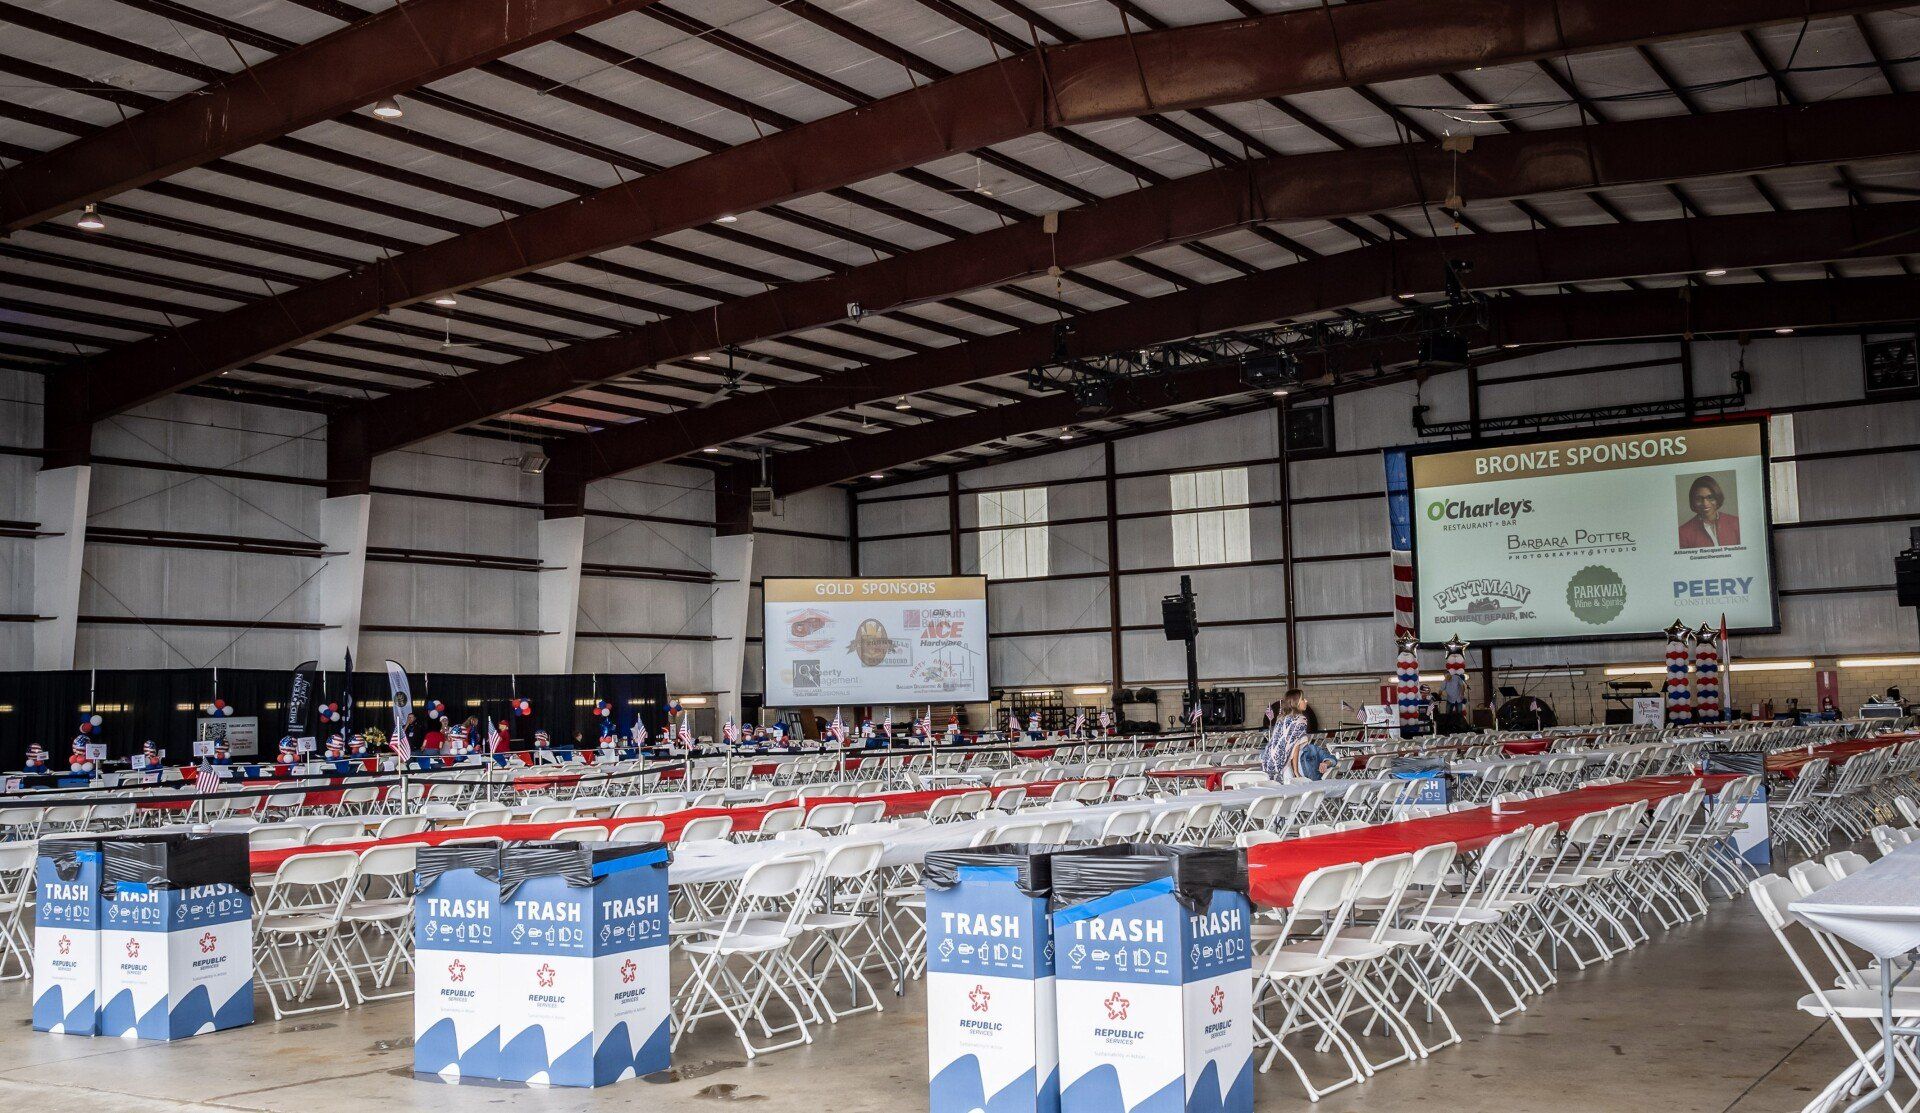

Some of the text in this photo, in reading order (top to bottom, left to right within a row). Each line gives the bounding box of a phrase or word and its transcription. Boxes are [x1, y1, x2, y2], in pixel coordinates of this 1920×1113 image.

[1475, 436, 1688, 475] BRONZE SPONSORS
[1427, 498, 1532, 521] O'Charley's
[1443, 521, 1493, 531] RESTAURANT
[1501, 519, 1517, 527] BAR
[1508, 550, 1585, 560] PHOTOGRAPHY
[1597, 546, 1637, 554] STUDIO
[815, 582, 936, 595] GOLD SPONSORS
[1433, 578, 1531, 610] PITTMAN
[1573, 583, 1627, 599] PARKWAY
[1673, 576, 1754, 599] PEERY
[1574, 600, 1593, 608] Wine
[1674, 595, 1750, 607] CONSTRUCTION
[1434, 614, 1481, 625] EQUIPMENT
[1519, 610, 1537, 620] INC.
[920, 620, 965, 639] ACE
[920, 639, 963, 647] Hardware
[45, 883, 89, 902] TRASH
[427, 898, 490, 919] TRASH
[514, 900, 581, 923] TRASH
[602, 894, 659, 921] TRASH
[941, 912, 1020, 939] TRASH
[1074, 918, 1164, 943] TRASH
[1190, 908, 1241, 939] TRASH
[52, 960, 77, 968] REPUBLIC
[120, 963, 148, 971] REPUBLIC
[192, 955, 227, 968] REPUBLIC
[440, 988, 475, 998] REPUBLIC
[528, 994, 566, 1004] REPUBLIC
[614, 987, 646, 1001] REPUBLIC
[959, 1019, 1003, 1031] REPUBLIC
[1204, 1019, 1232, 1035] REPUBLIC
[969, 1028, 993, 1037] SERVICES
[1094, 1028, 1145, 1040] REPUBLIC
[1105, 1037, 1134, 1045] SERVICES
